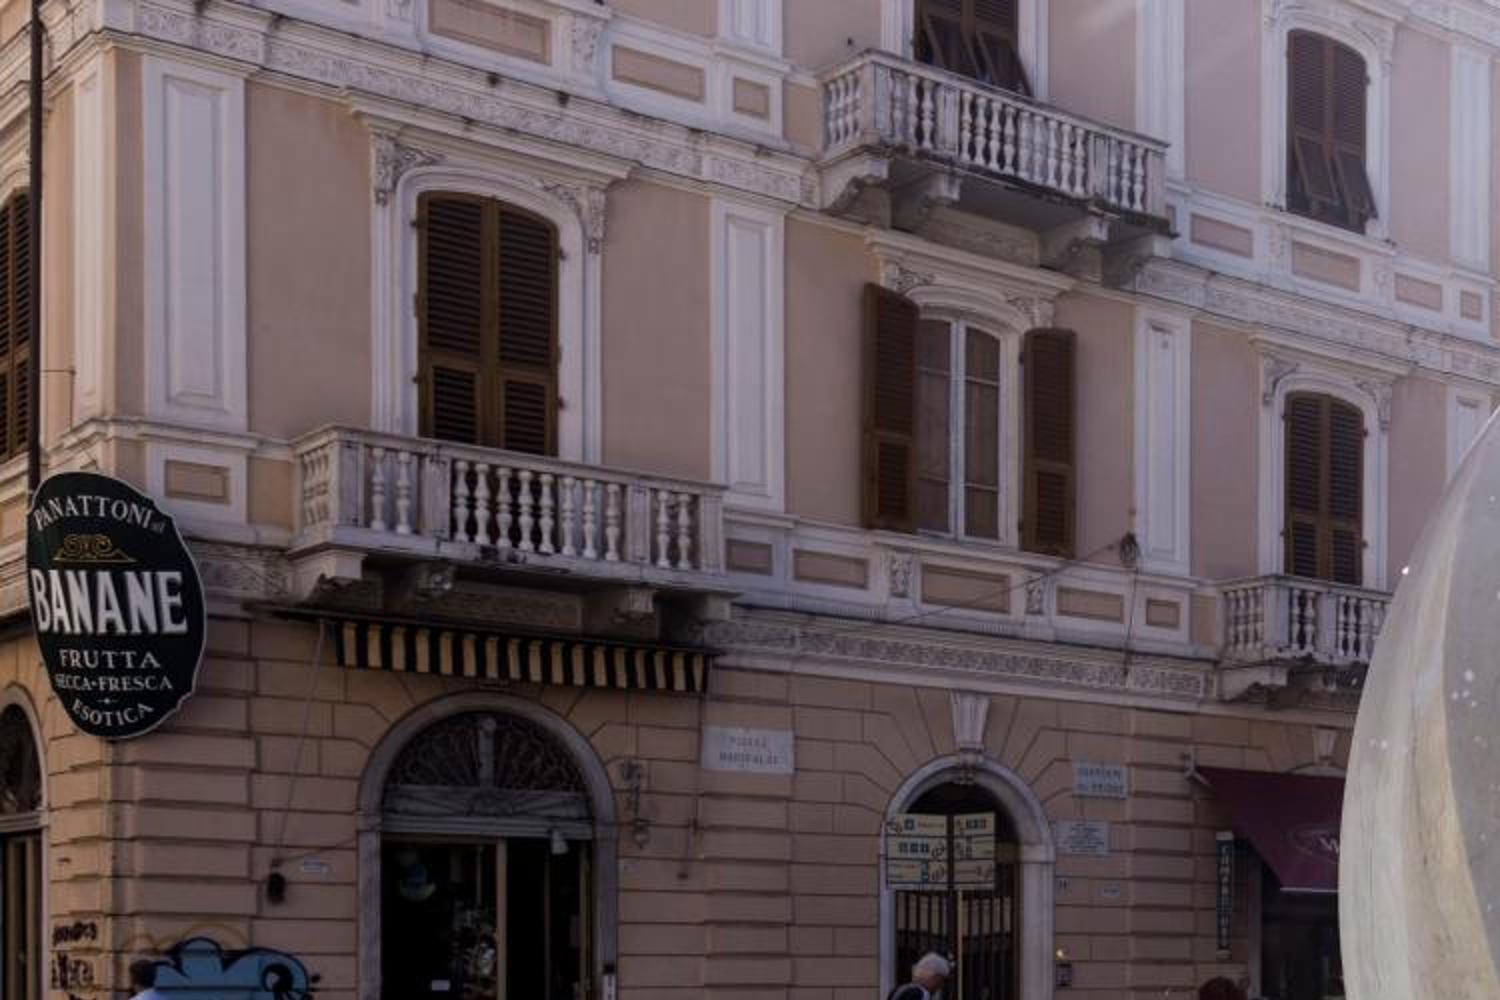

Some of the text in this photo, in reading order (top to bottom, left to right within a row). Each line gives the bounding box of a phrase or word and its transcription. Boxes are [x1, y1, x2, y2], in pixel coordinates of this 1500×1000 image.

[34, 495, 152, 532] PANATTONI
[32, 568, 188, 635] BANANE
[59, 649, 160, 669] FRUTTA
[72, 699, 154, 727] ESOTICA
